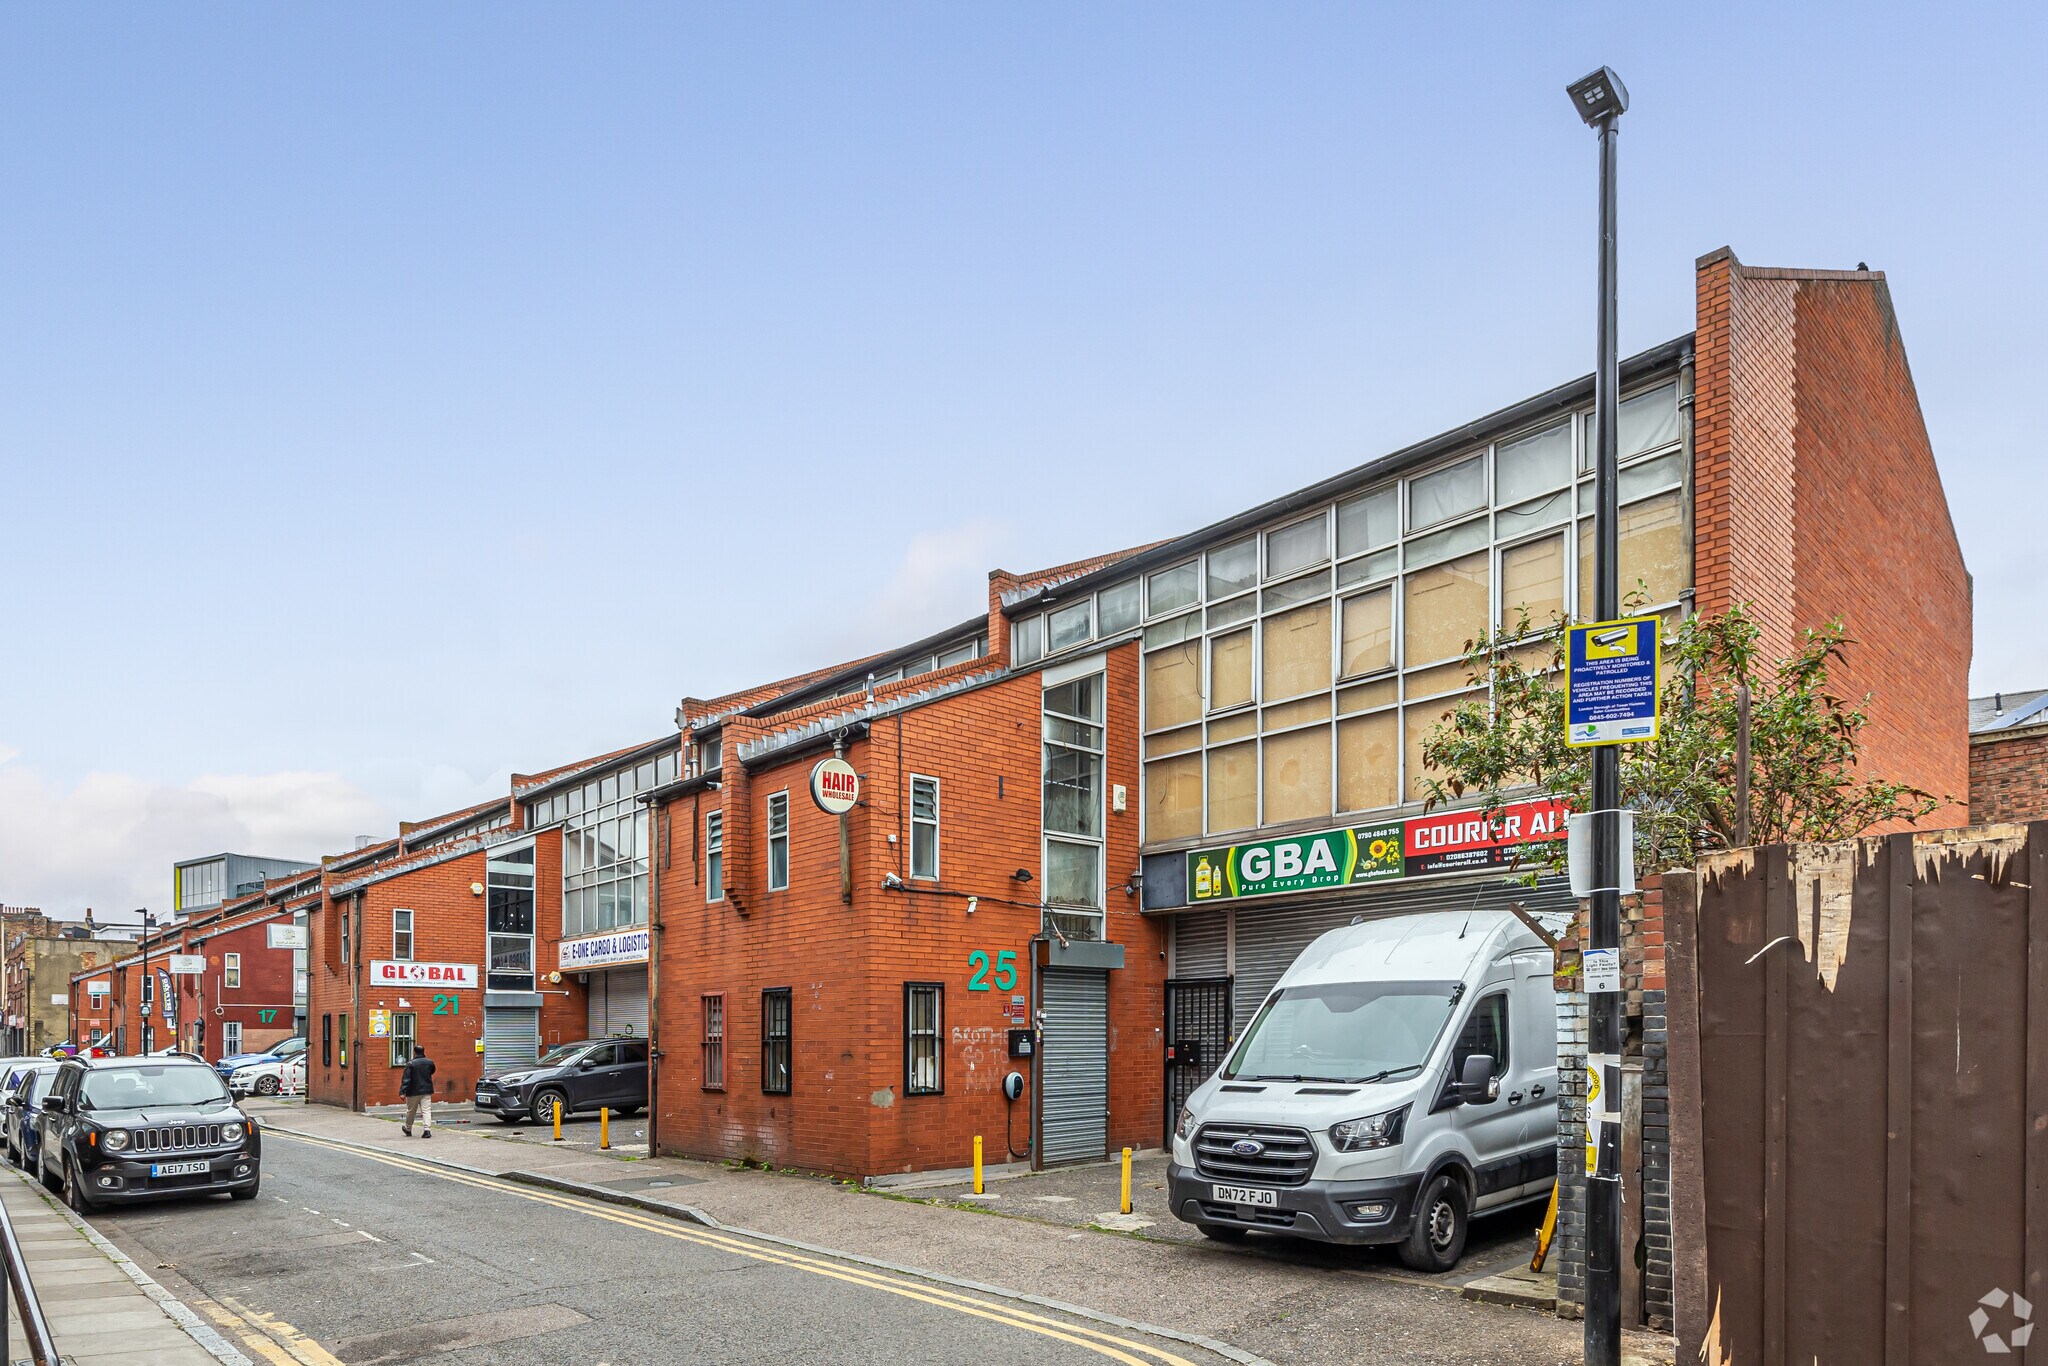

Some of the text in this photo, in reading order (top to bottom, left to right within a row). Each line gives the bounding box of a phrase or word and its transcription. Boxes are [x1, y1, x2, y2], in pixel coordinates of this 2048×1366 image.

[1589, 712, 1634, 720] 0845-602-7494
[822, 771, 854, 792] HAIR
[822, 790, 854, 801] WHOLESALE
[1415, 816, 1521, 849] COURIER
[1241, 839, 1337, 882] GBA
[1273, 879, 1304, 887] Every
[573, 942, 588, 959] E-ONE
[591, 939, 610, 956] CARGO
[613, 938, 617, 954] &
[968, 950, 1018, 991] 25
[432, 994, 459, 1015] 21
[258, 1009, 277, 1023] 17
[952, 1027, 1030, 1044] BROTHE
[162, 1163, 205, 1174] AE17 TSO
[1218, 1187, 1272, 1204] DN72 FJO
